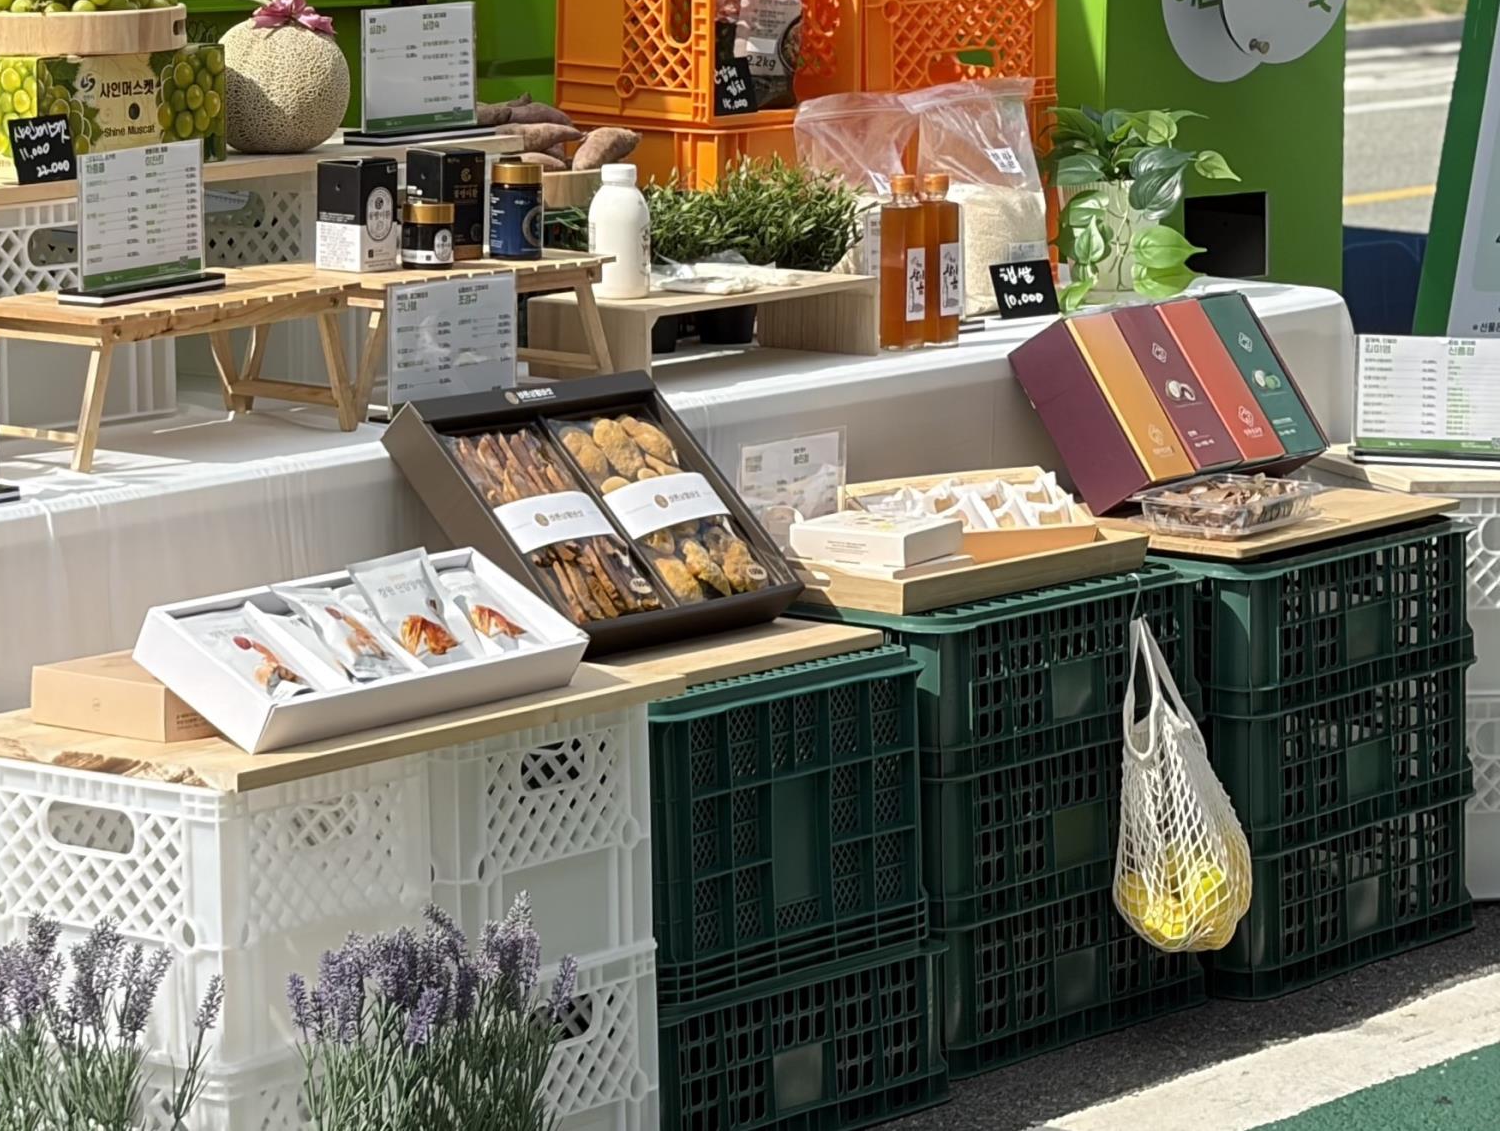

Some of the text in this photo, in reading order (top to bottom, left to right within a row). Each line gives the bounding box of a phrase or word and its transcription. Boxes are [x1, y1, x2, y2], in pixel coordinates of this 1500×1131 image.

[104, 124, 156, 138] Shine Muscat
[999, 265, 1035, 286] 햅쌀
